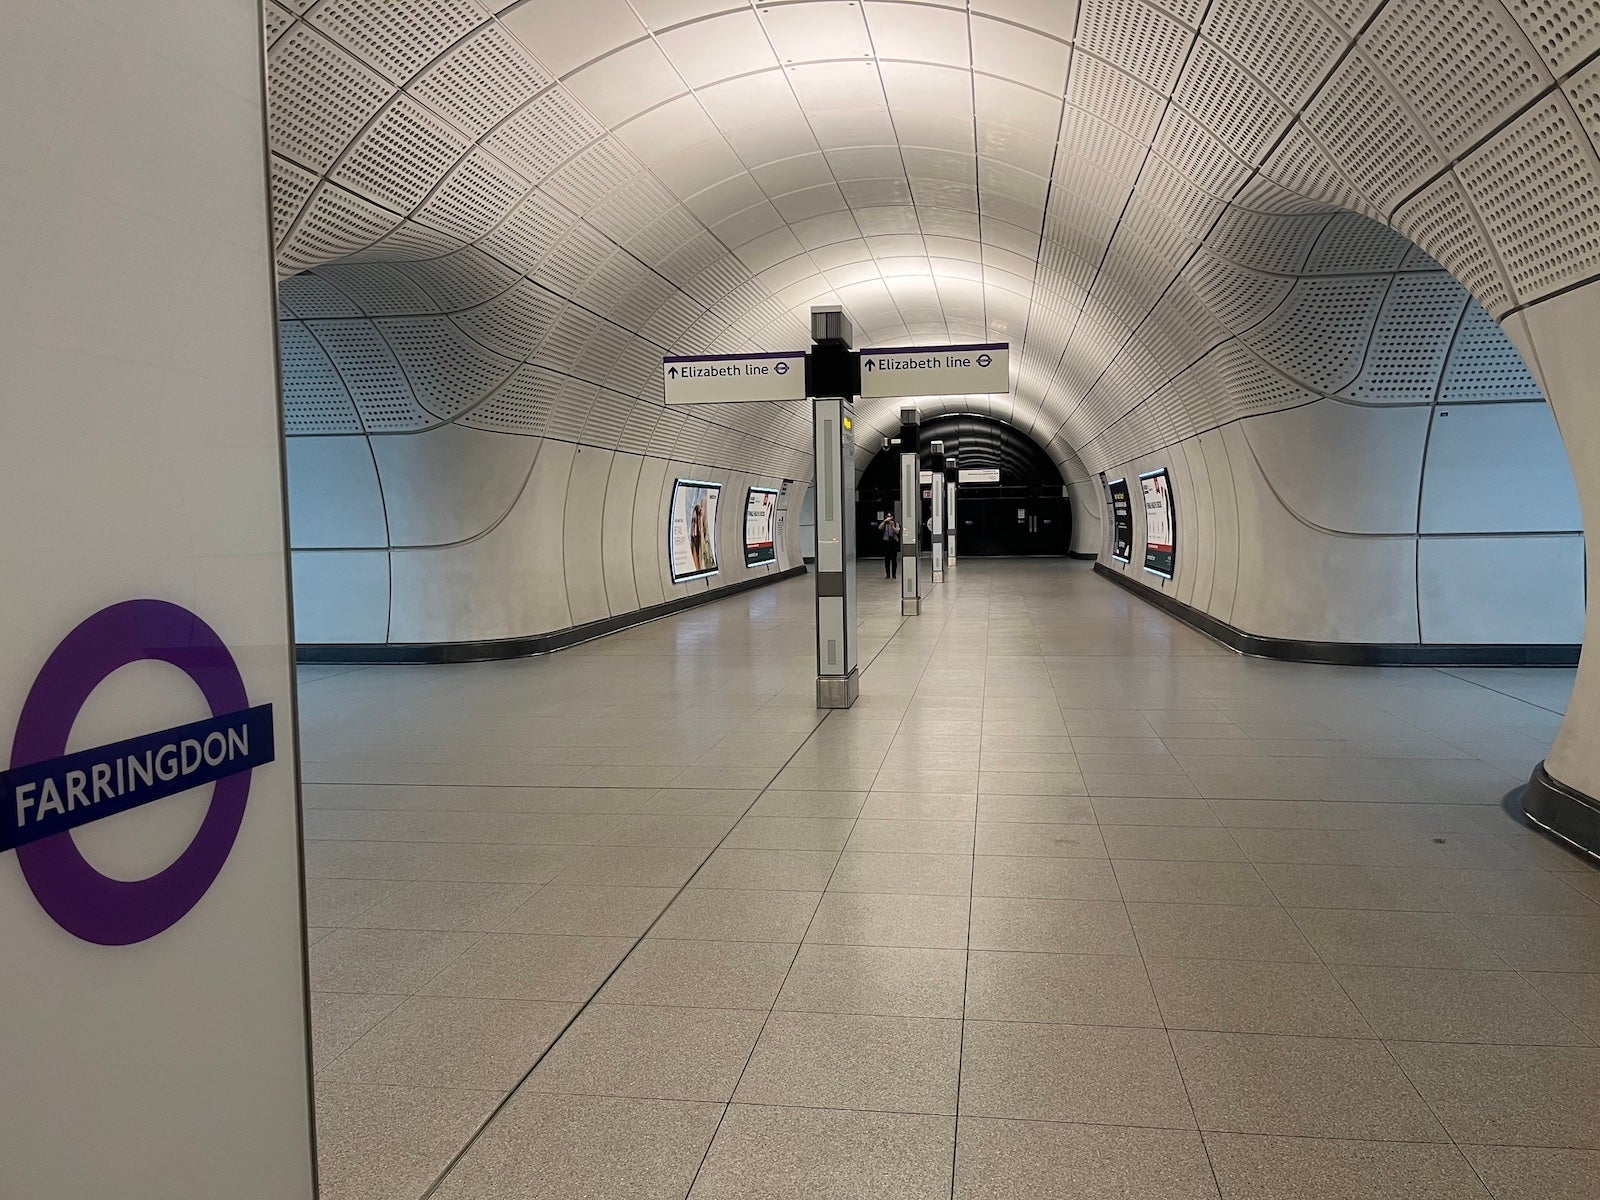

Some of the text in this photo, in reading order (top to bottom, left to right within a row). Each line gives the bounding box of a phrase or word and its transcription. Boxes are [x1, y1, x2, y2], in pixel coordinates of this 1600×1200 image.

[681, 364, 769, 378] Elizabeth line
[879, 356, 971, 371] Elizabeth line
[15, 724, 250, 827] FARRINGDON
